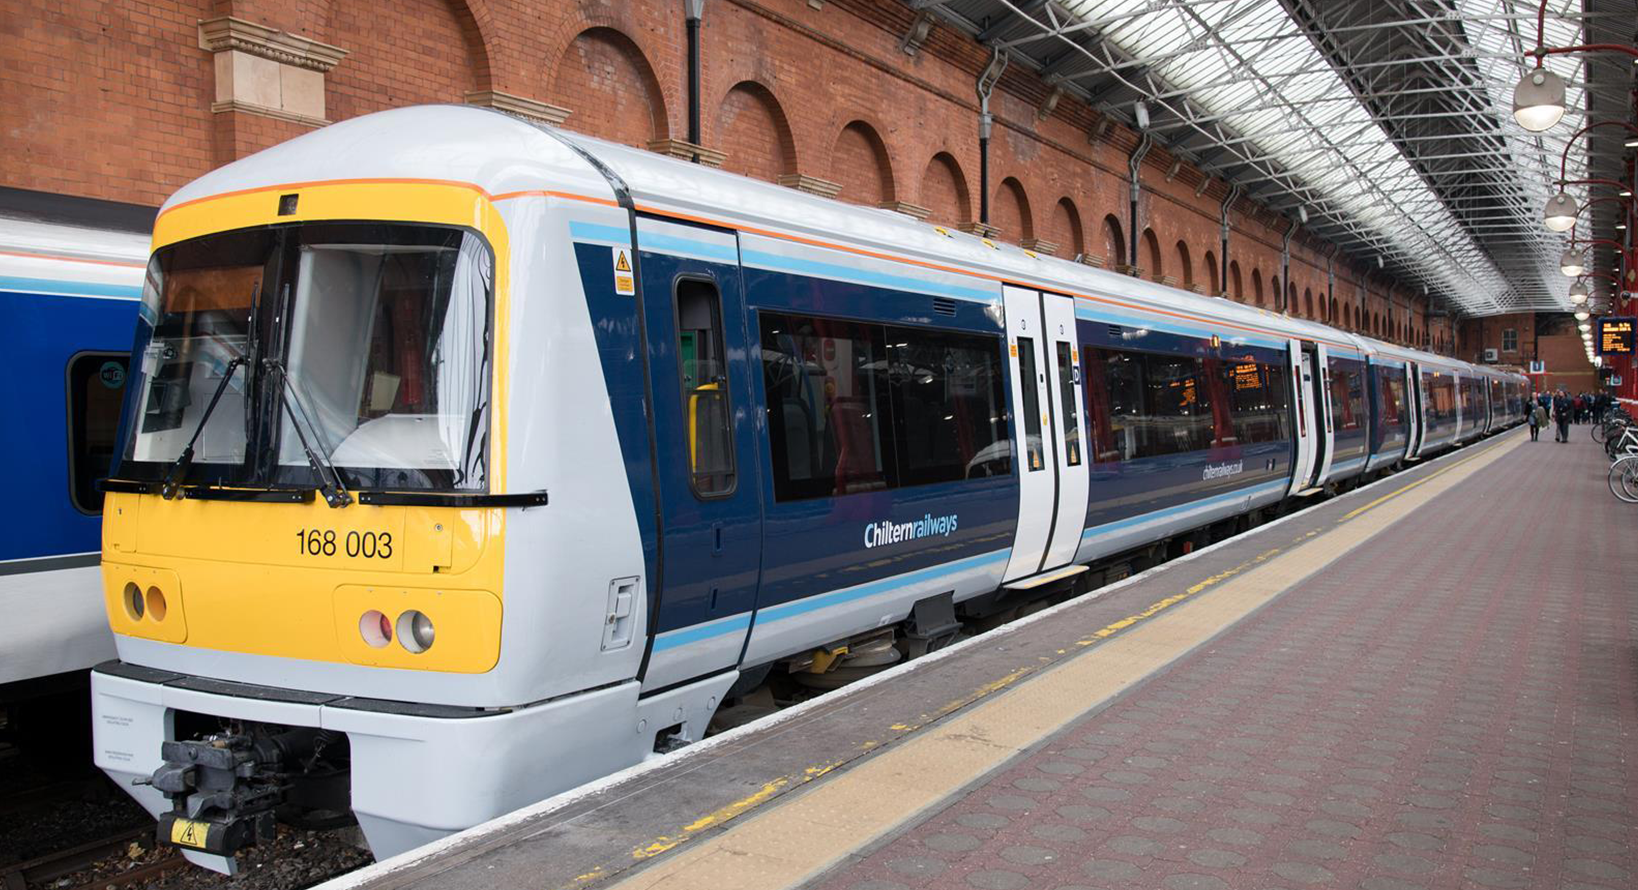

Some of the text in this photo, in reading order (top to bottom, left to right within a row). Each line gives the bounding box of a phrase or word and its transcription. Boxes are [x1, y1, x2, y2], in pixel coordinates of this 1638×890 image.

[296, 528, 393, 559] 168 003
[864, 513, 958, 549] Chilternrailways
